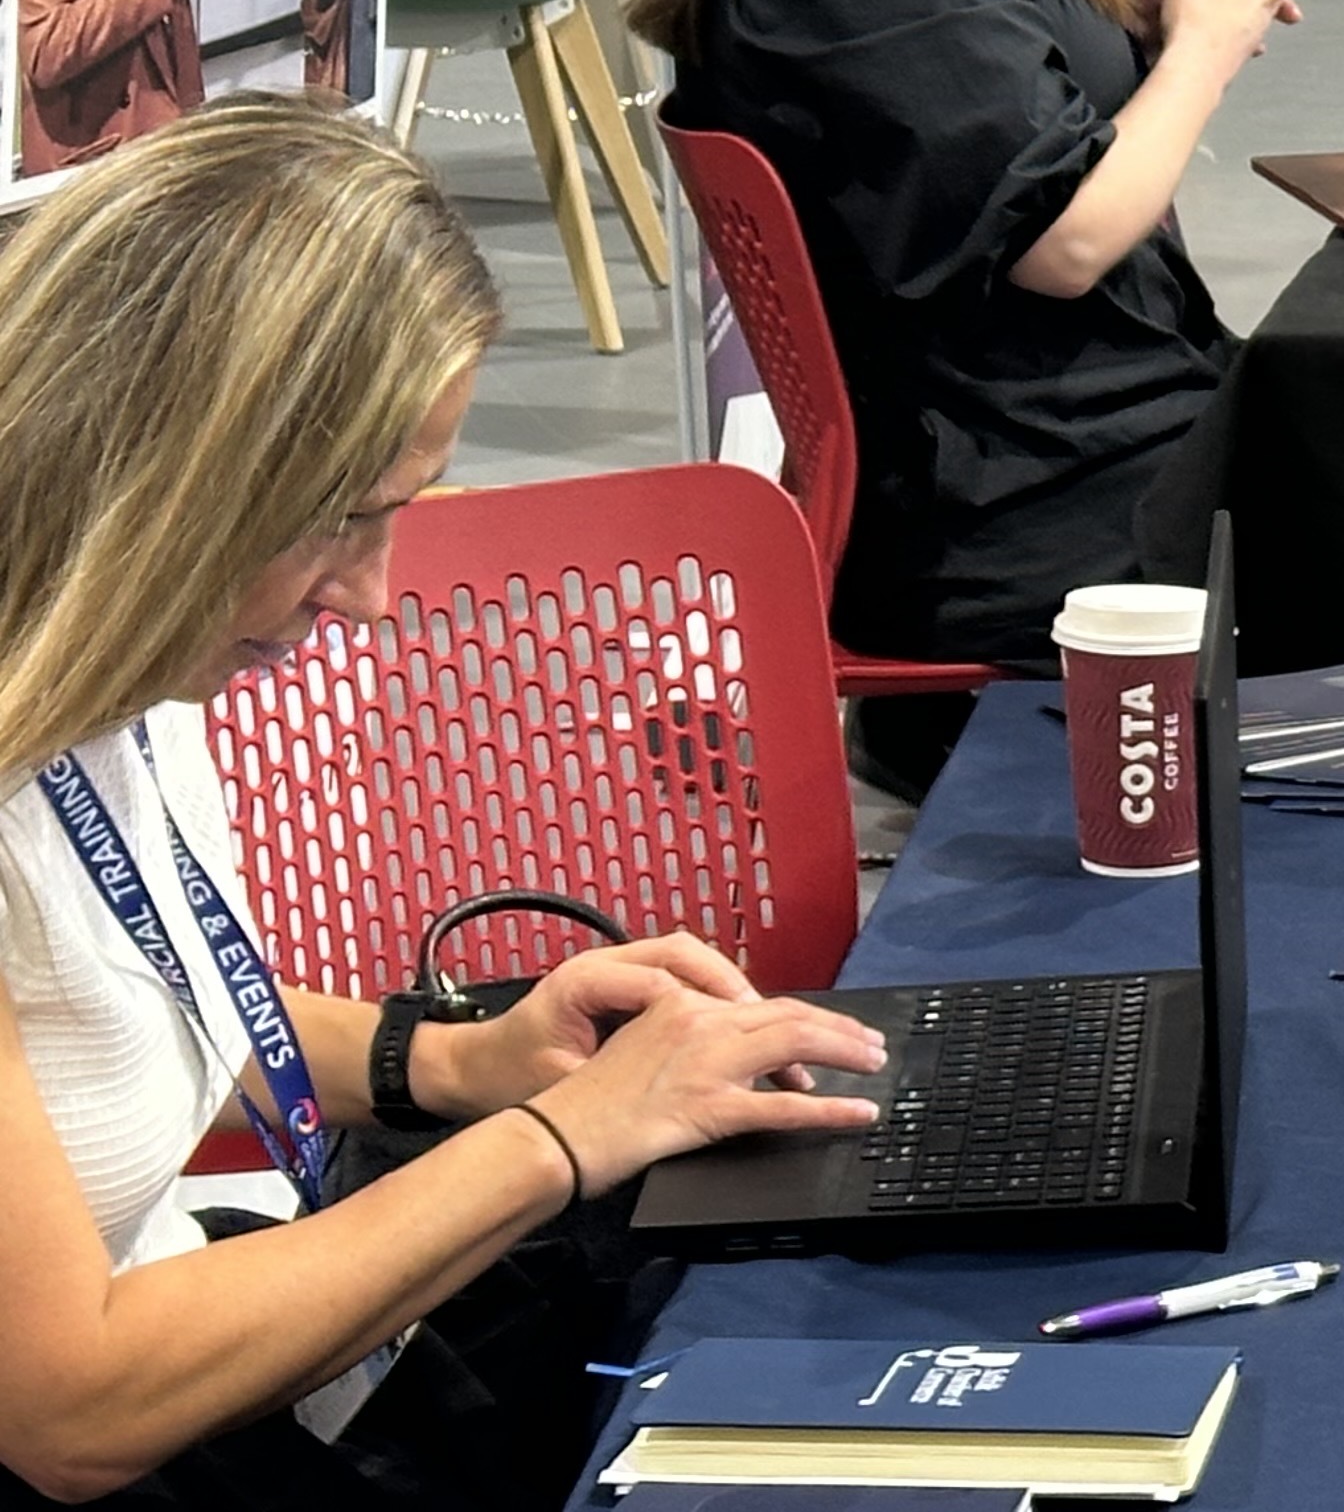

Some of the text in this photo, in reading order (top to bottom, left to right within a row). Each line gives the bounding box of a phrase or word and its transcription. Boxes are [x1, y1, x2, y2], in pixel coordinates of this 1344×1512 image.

[1118, 682, 1159, 825] COSTA
[1163, 712, 1180, 791] COFFEE
[44, 751, 139, 904] TRAINING
[201, 914, 229, 938] &
[217, 945, 296, 1071] EVENTS
